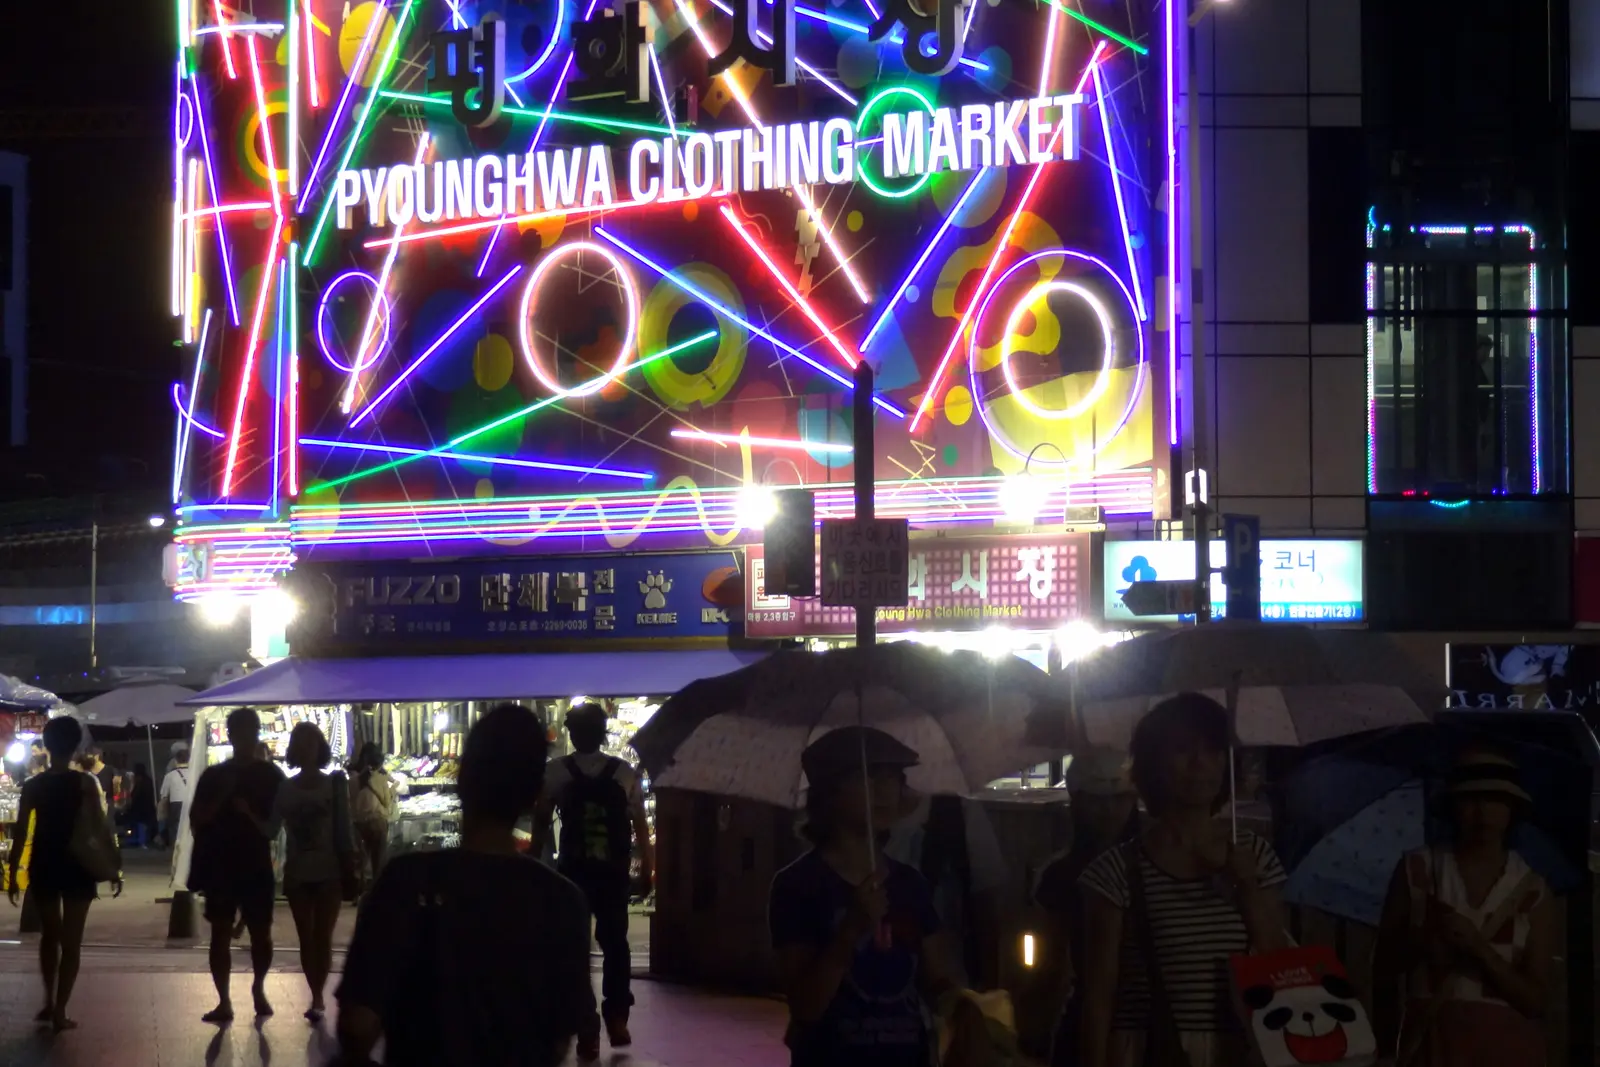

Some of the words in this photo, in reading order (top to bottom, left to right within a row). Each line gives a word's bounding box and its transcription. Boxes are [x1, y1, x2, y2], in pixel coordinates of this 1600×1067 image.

[336, 144, 617, 230] PYOUNGHWA
[629, 117, 857, 204] CLOTHING
[883, 93, 1088, 178] MARKET
[1234, 522, 1252, 569] P
[1273, 549, 1316, 573] 코너
[345, 574, 461, 607] FUZZO
[636, 612, 678, 624] KELME
[908, 607, 932, 619] Hwa
[934, 606, 980, 619] Clothing
[983, 604, 1022, 617] Market
